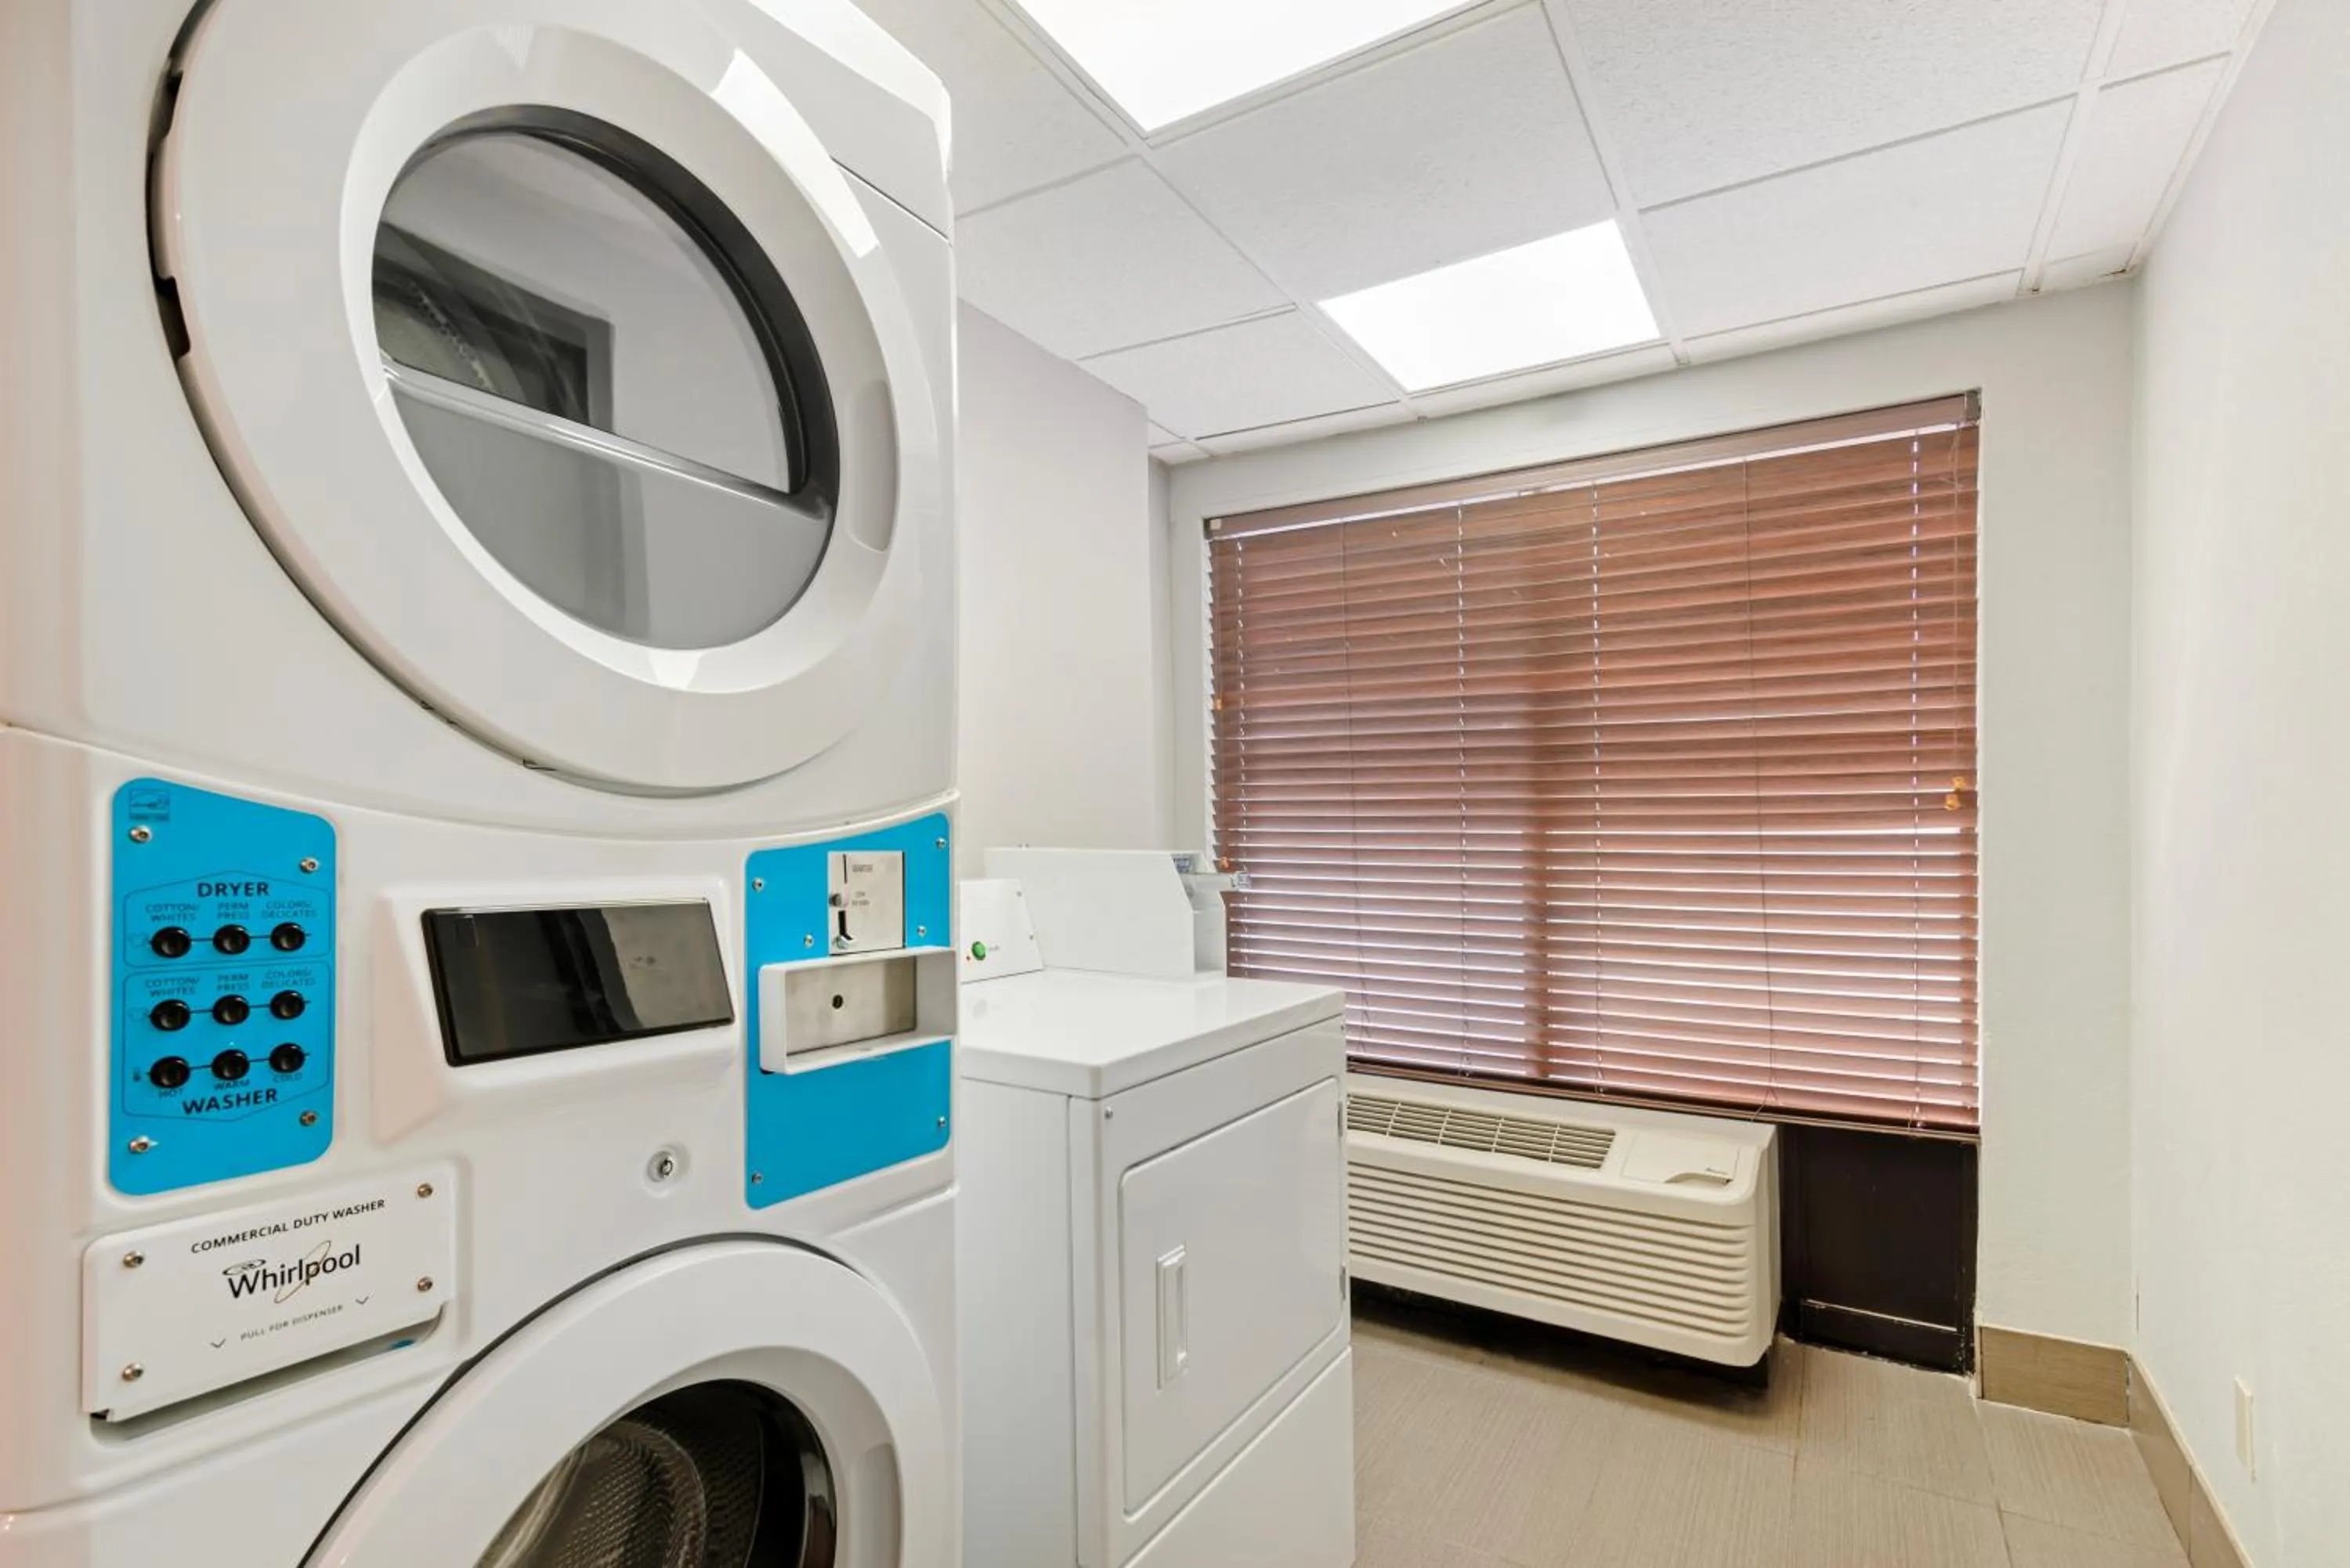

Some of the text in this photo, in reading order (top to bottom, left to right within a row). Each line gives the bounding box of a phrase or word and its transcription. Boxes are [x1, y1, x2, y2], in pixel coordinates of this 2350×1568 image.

[197, 882, 269, 898] DRYER
[217, 901, 249, 912] PERM
[150, 912, 197, 923] WHITES
[217, 911, 249, 921] PRESS
[217, 973, 249, 983] PERM
[150, 987, 196, 999] WHITES
[183, 1088, 278, 1116] WASHER
[190, 1199, 385, 1254] COMMERCIAL DUTY WASHER
[226, 1245, 360, 1299] Whirlpool
[240, 1304, 343, 1342] PULL FOR DISPENSER
